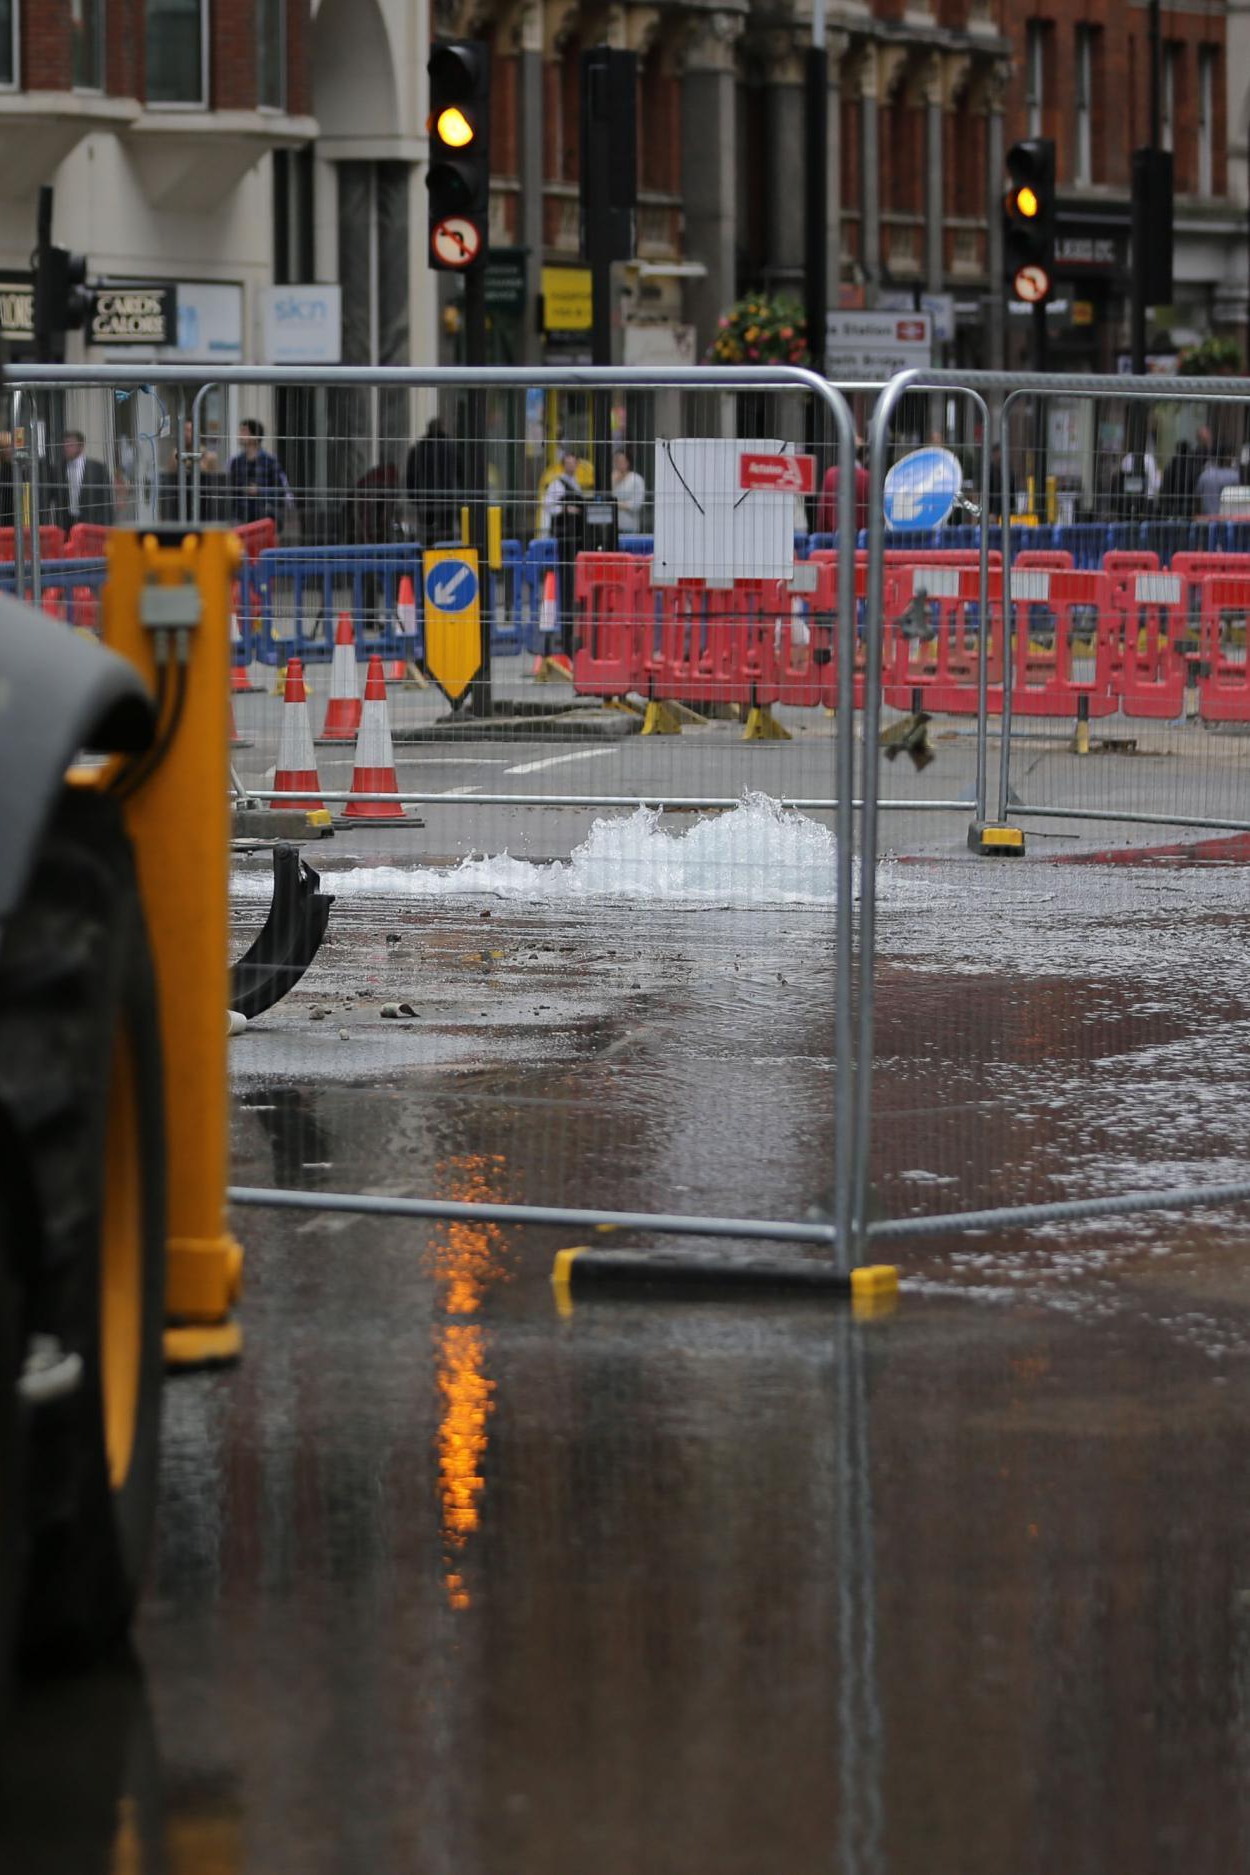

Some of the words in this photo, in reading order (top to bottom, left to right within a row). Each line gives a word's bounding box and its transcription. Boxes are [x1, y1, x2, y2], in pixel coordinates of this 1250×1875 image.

[97, 296, 162, 316] CARDS
[92, 315, 166, 334] GALORE
[842, 322, 891, 336] Station
[862, 354, 906, 372] Bridge
